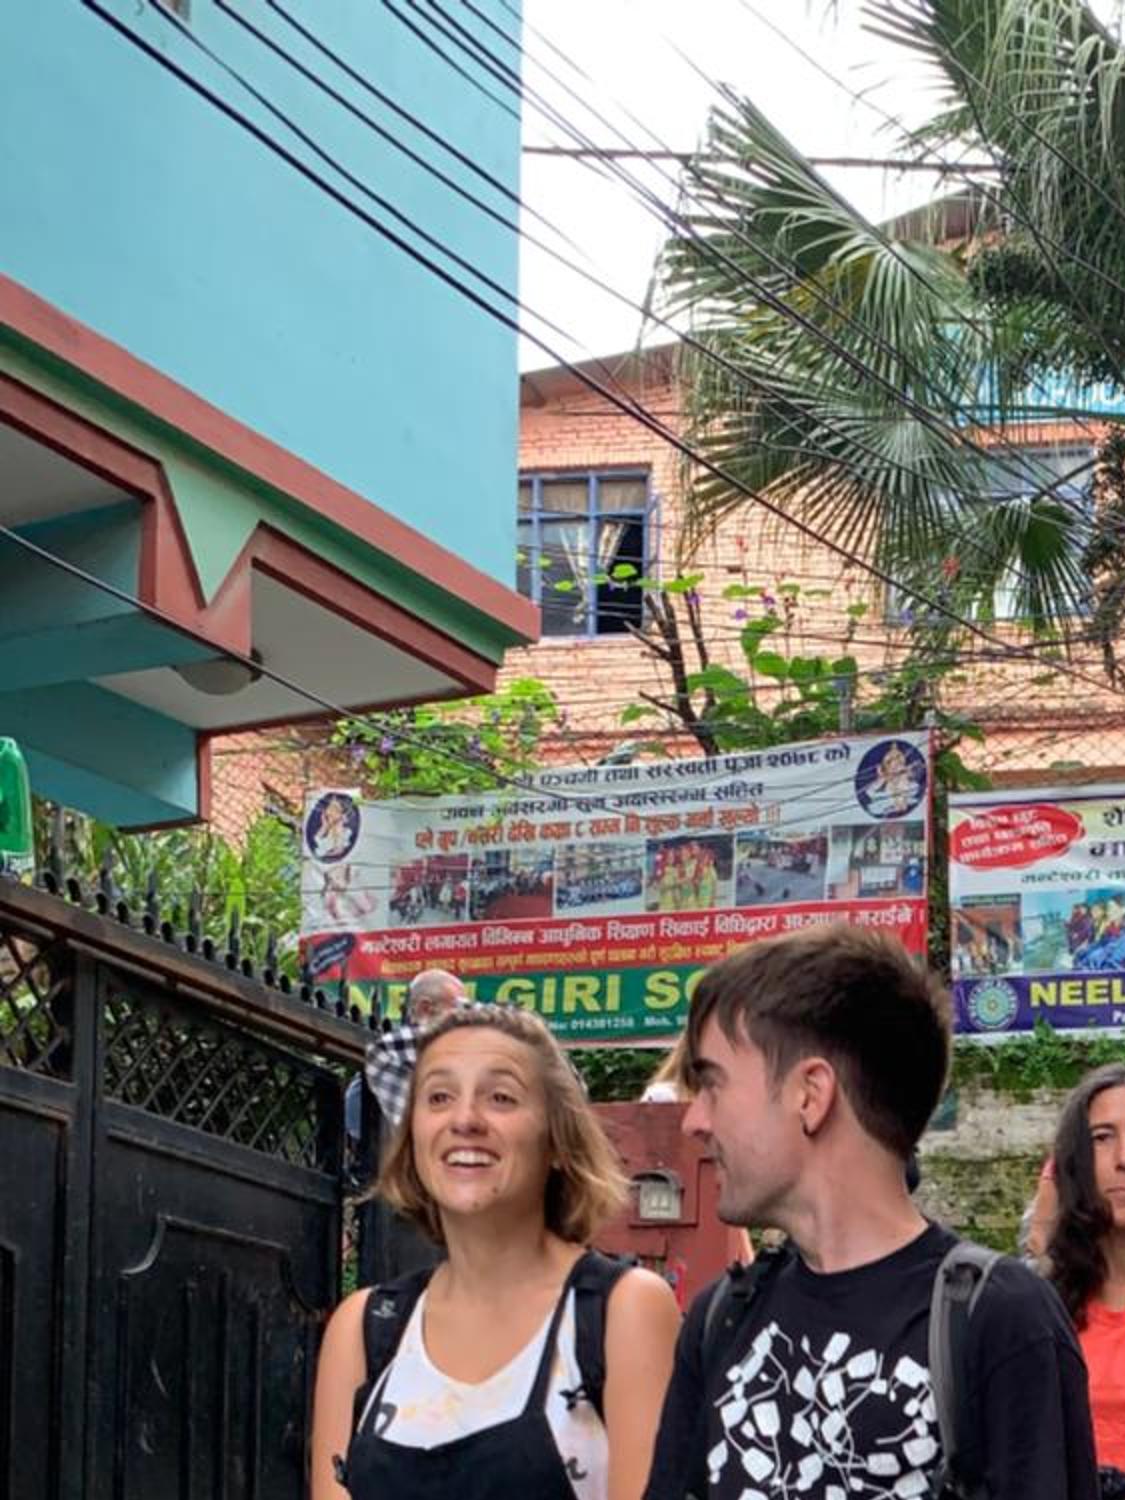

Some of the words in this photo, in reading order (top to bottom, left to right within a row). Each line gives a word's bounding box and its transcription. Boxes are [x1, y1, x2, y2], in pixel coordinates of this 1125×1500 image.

[604, 766, 639, 783] तथा
[648, 758, 719, 780] सरस्वती
[724, 754, 763, 779] पूजा
[824, 743, 851, 763] को
